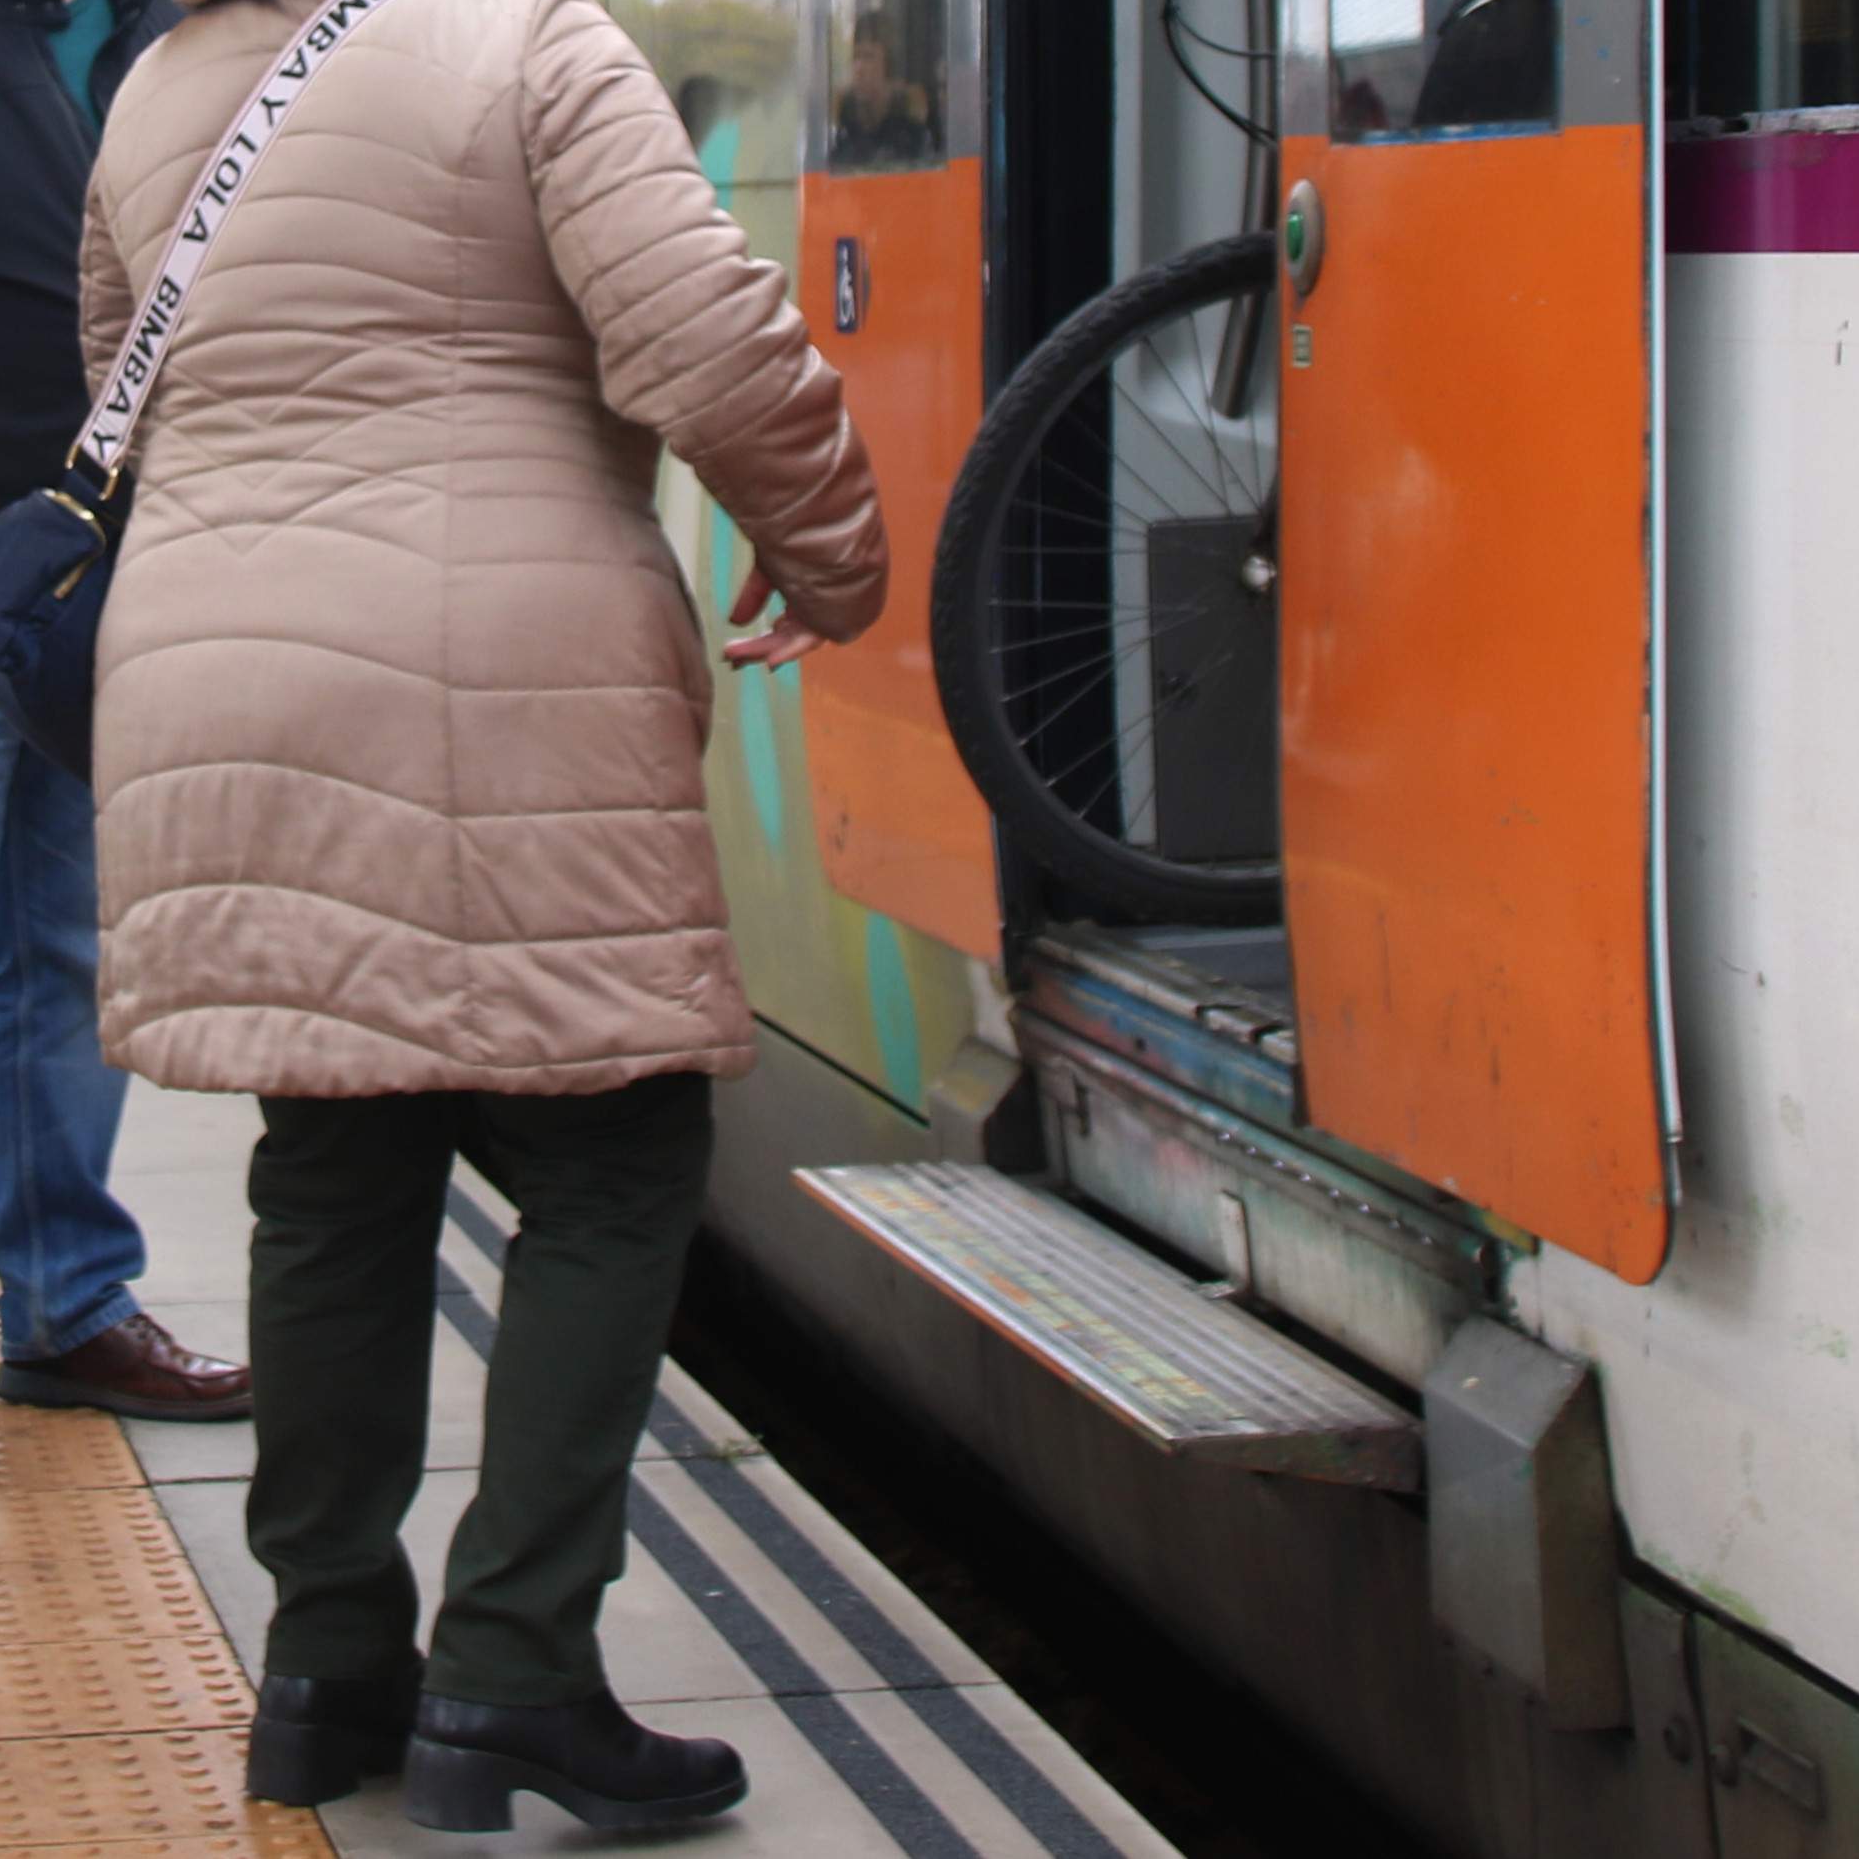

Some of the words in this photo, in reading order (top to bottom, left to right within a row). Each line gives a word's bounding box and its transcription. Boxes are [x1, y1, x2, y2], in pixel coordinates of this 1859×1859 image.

[259, 94, 288, 130] Y
[181, 132, 261, 246] LOLA
[106, 273, 183, 415] BIMBA
[91, 427, 122, 461] Y
